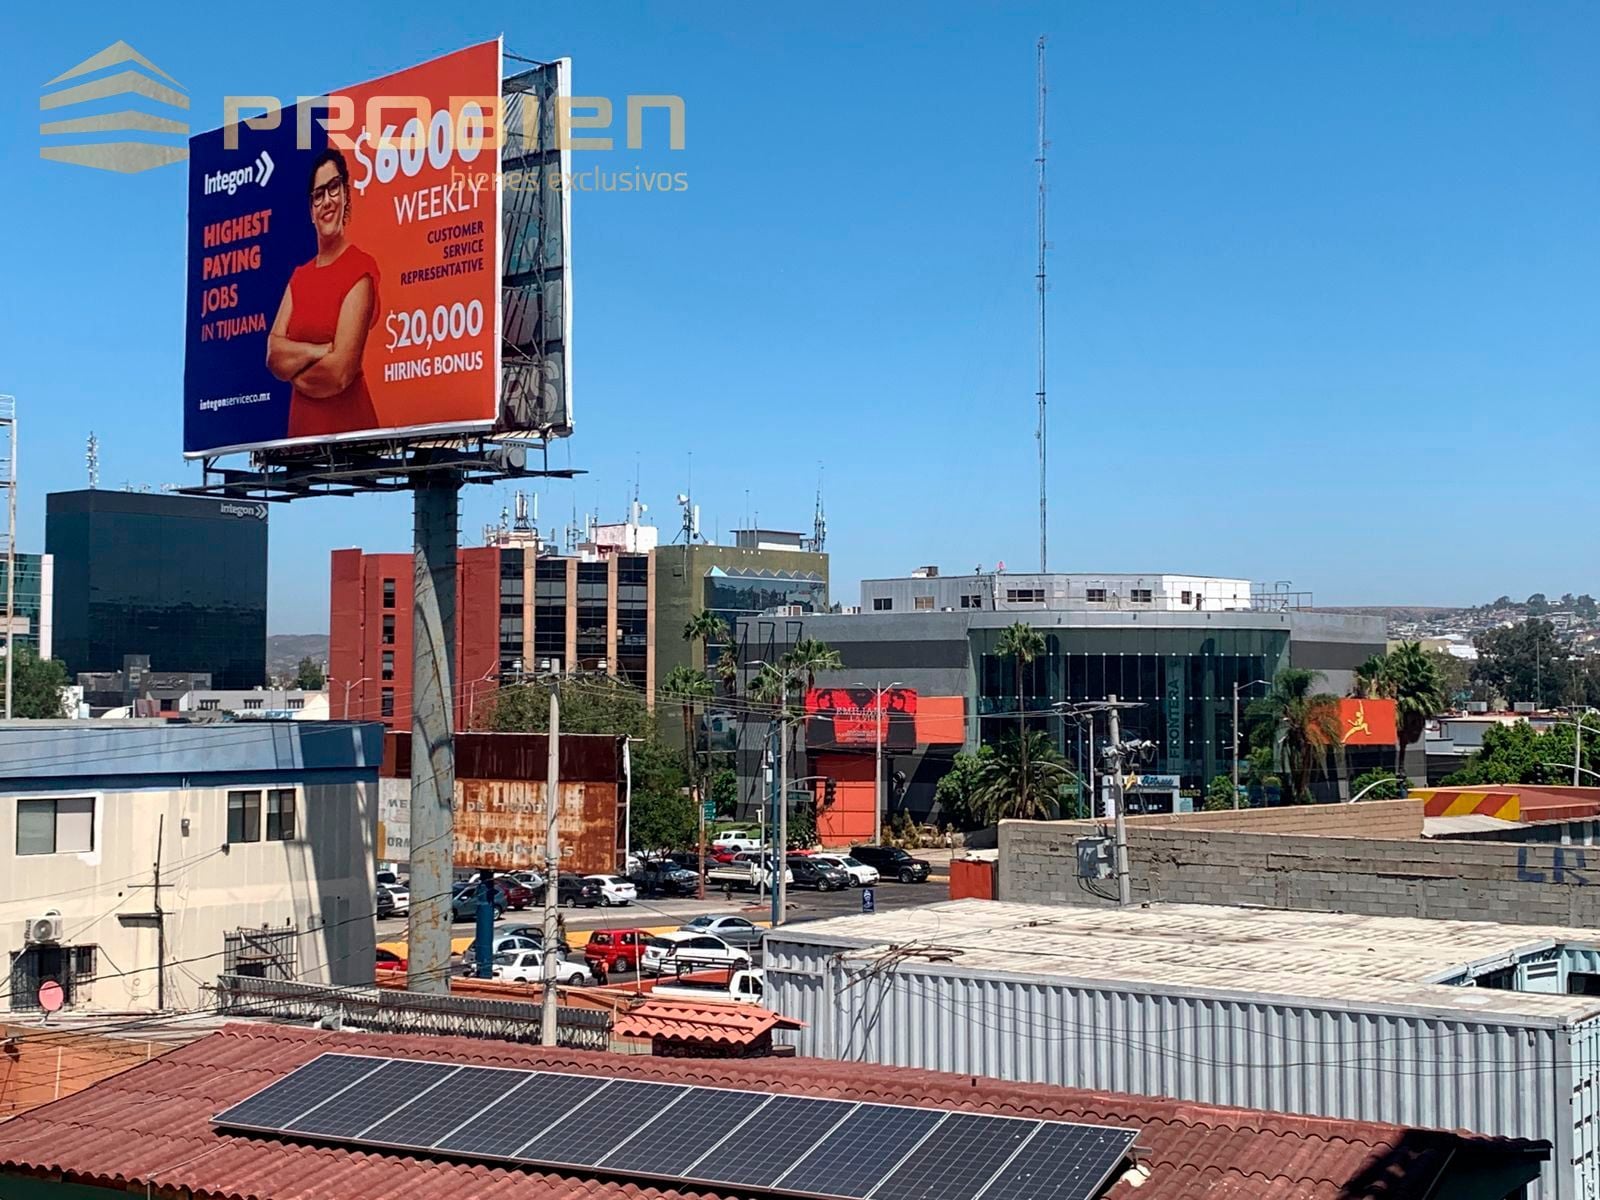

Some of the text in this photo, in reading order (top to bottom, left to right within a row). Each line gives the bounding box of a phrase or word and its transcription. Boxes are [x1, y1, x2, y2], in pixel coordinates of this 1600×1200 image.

[354, 101, 484, 196] $6000
[204, 166, 253, 195] Integon
[394, 175, 485, 225] WEEKLY
[203, 209, 272, 249] HIGHEST
[427, 221, 484, 244] CUSTOMER
[203, 245, 261, 280] PAYING
[443, 239, 484, 259] SERVICE
[401, 258, 484, 286] REPRESENTATIVE
[201, 284, 238, 317] JOBS
[201, 313, 266, 342] IN TIJUANA
[385, 299, 484, 353] $20,000
[384, 351, 483, 382] HIRING BONUS
[220, 503, 254, 517] Integon
[1168, 679, 1180, 759] FRONTERA
